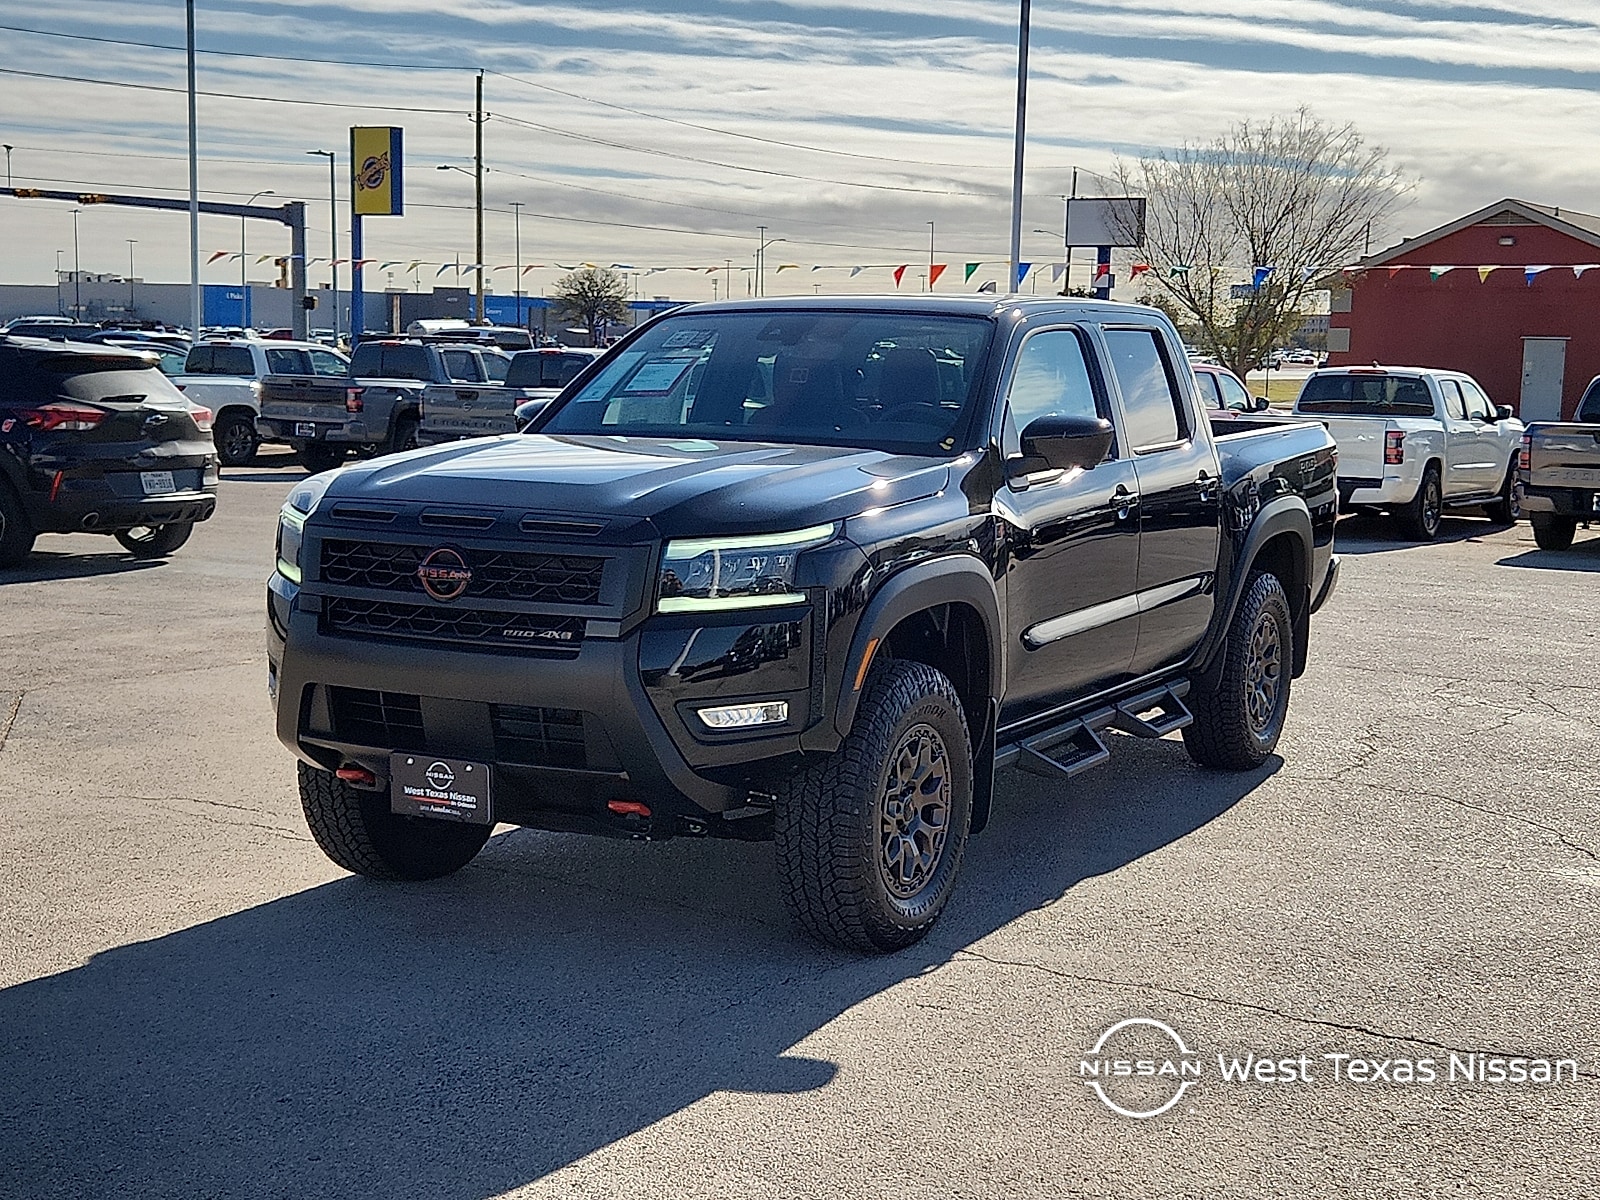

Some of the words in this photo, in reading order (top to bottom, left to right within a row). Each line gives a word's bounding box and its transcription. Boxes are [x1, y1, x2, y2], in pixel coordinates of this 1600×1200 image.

[426, 772, 454, 780] NISSAN
[404, 786, 424, 796] West
[425, 789, 449, 799] Texas
[450, 792, 476, 803] Nissan
